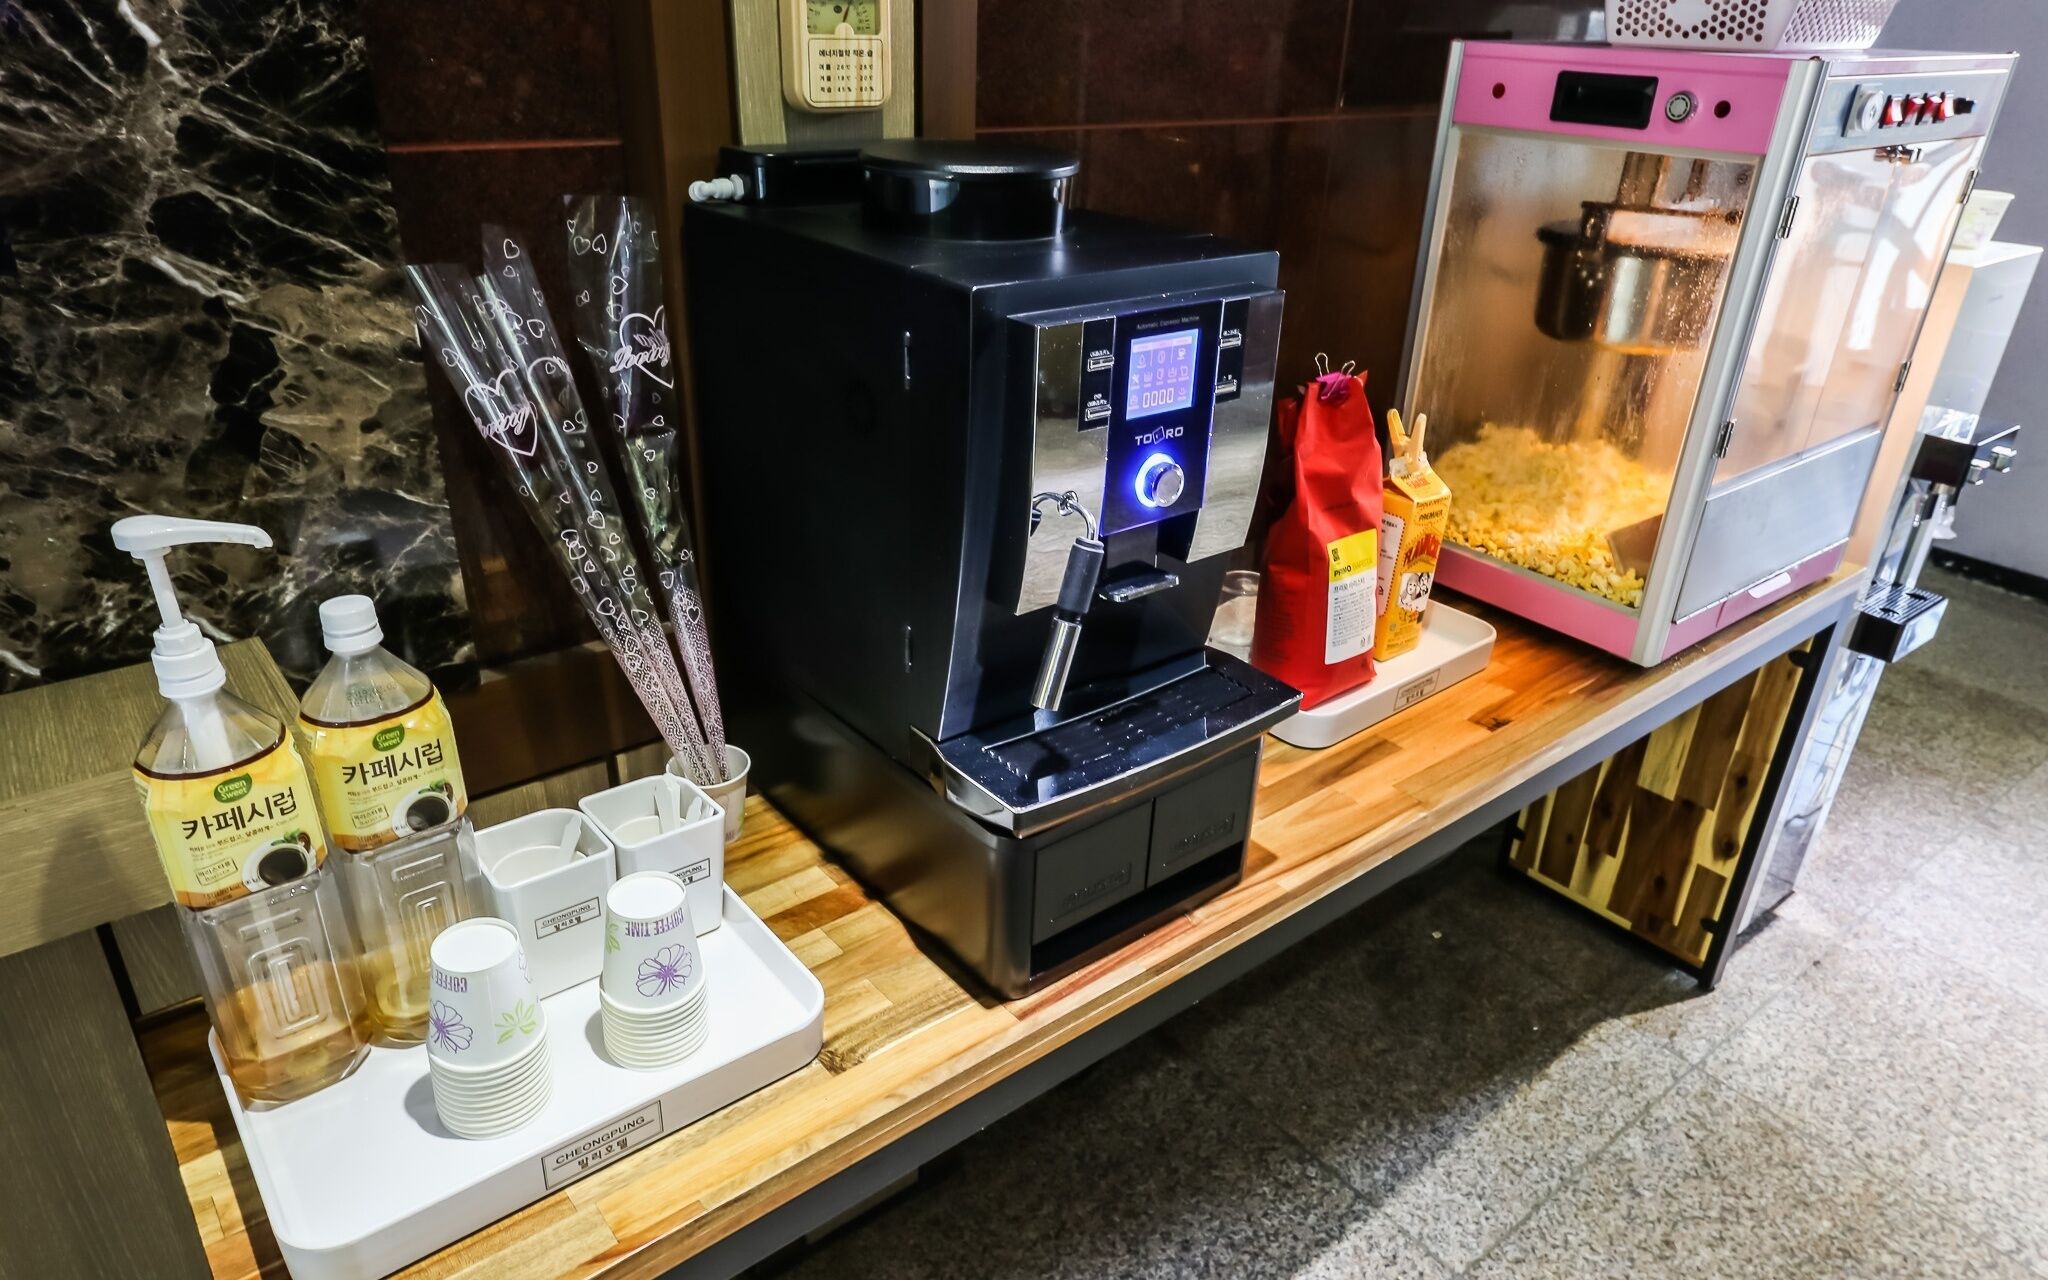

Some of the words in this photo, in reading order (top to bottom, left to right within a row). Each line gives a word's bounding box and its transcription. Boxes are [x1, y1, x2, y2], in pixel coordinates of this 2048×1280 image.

[1142, 387, 1175, 409] 0000
[376, 729, 400, 743] Green
[378, 737, 401, 750] Sweet
[342, 738, 443, 785] 카페시럽
[217, 778, 247, 794] Green
[220, 787, 248, 801] Sweet
[181, 786, 297, 840] 카페시럽
[542, 904, 591, 927] CHEONGPUNG
[652, 906, 684, 936] COFFEE
[625, 921, 651, 938] TIME
[435, 968, 468, 993] COFFEE
[556, 1115, 646, 1165] CHEONGPUNG
[577, 1136, 629, 1171] 발리호텔
